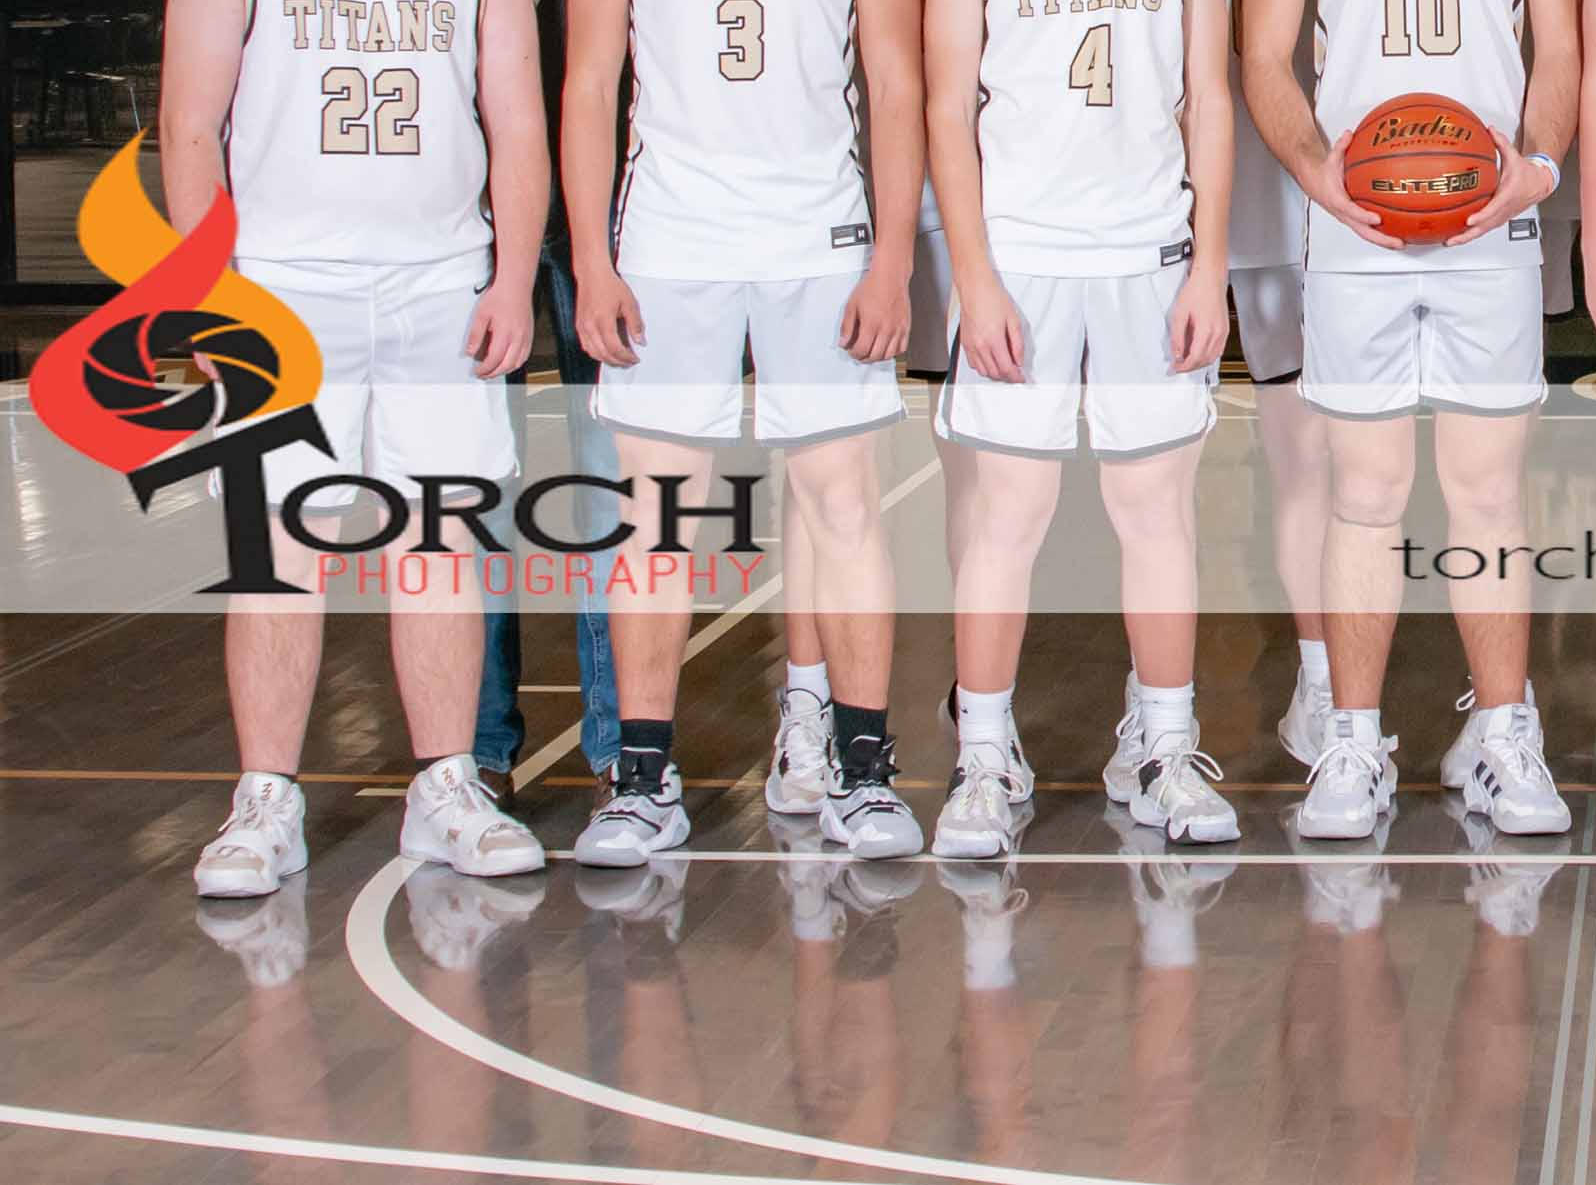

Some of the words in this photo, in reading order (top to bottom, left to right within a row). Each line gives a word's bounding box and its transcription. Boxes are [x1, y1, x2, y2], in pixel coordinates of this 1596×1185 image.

[1069, 24, 1112, 107] 4
[320, 67, 420, 155] 22
[1372, 116, 1472, 147] Baden
[1371, 177, 1449, 195] ELITE
[1448, 170, 1479, 192] PRO
